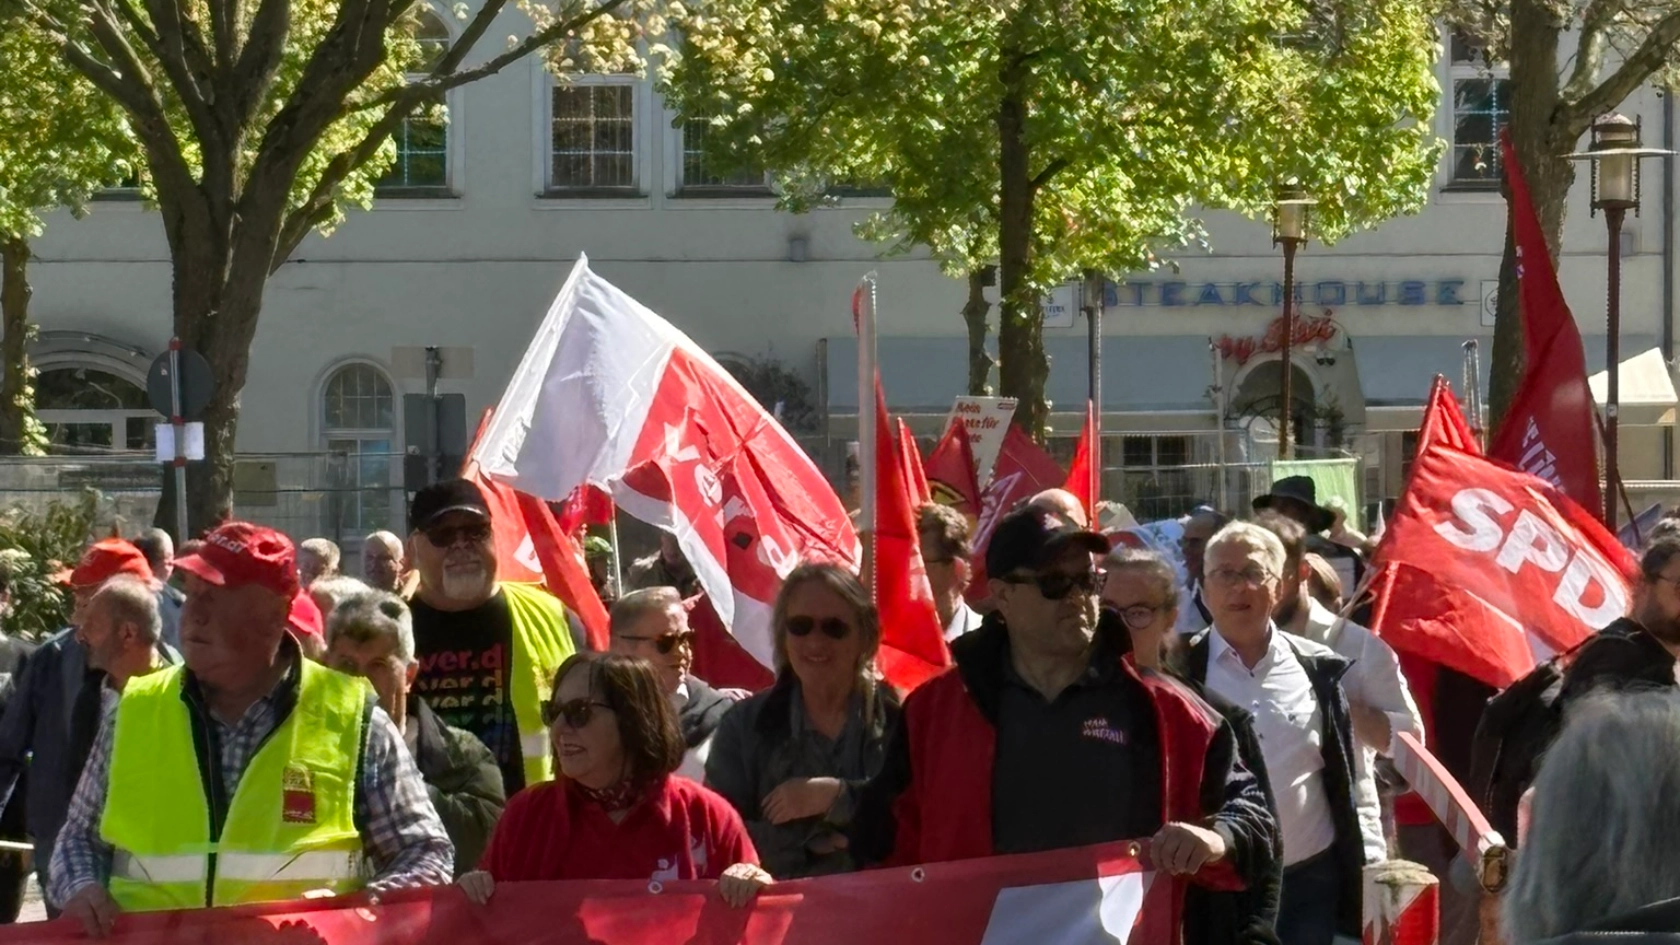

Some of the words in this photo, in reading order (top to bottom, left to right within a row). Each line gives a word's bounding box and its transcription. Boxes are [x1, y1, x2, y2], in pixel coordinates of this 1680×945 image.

[663, 404, 798, 580] ver.d
[1433, 488, 1628, 629] SPD
[418, 642, 504, 673] ver.d
